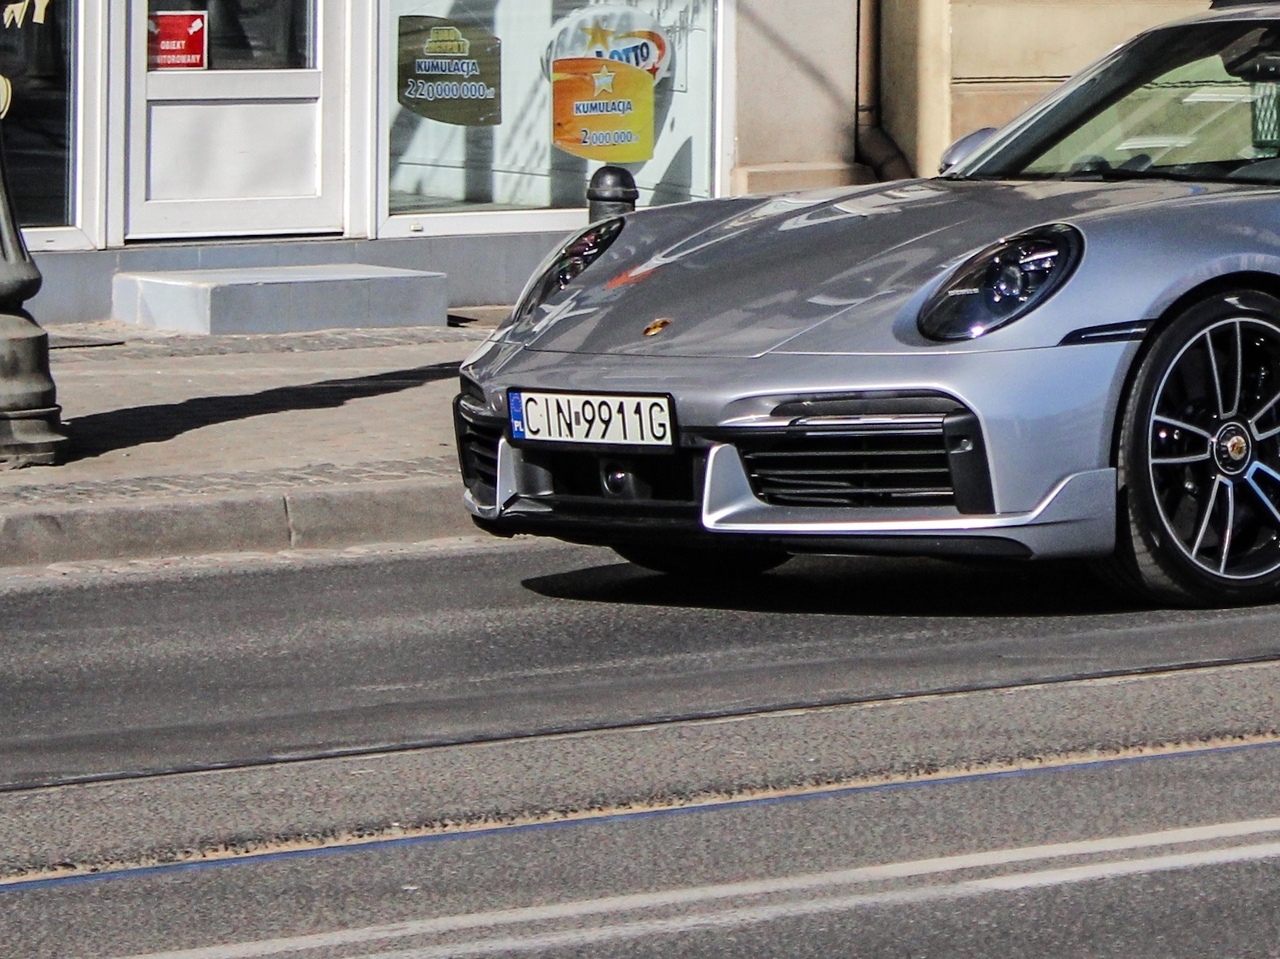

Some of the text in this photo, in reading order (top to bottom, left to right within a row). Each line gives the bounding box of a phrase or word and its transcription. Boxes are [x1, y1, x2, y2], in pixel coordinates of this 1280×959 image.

[415, 59, 480, 78] KUMULACJA
[573, 100, 634, 116] KUMULACJA
[514, 420, 525, 432] PL
[524, 397, 668, 441] CIN 9911G
